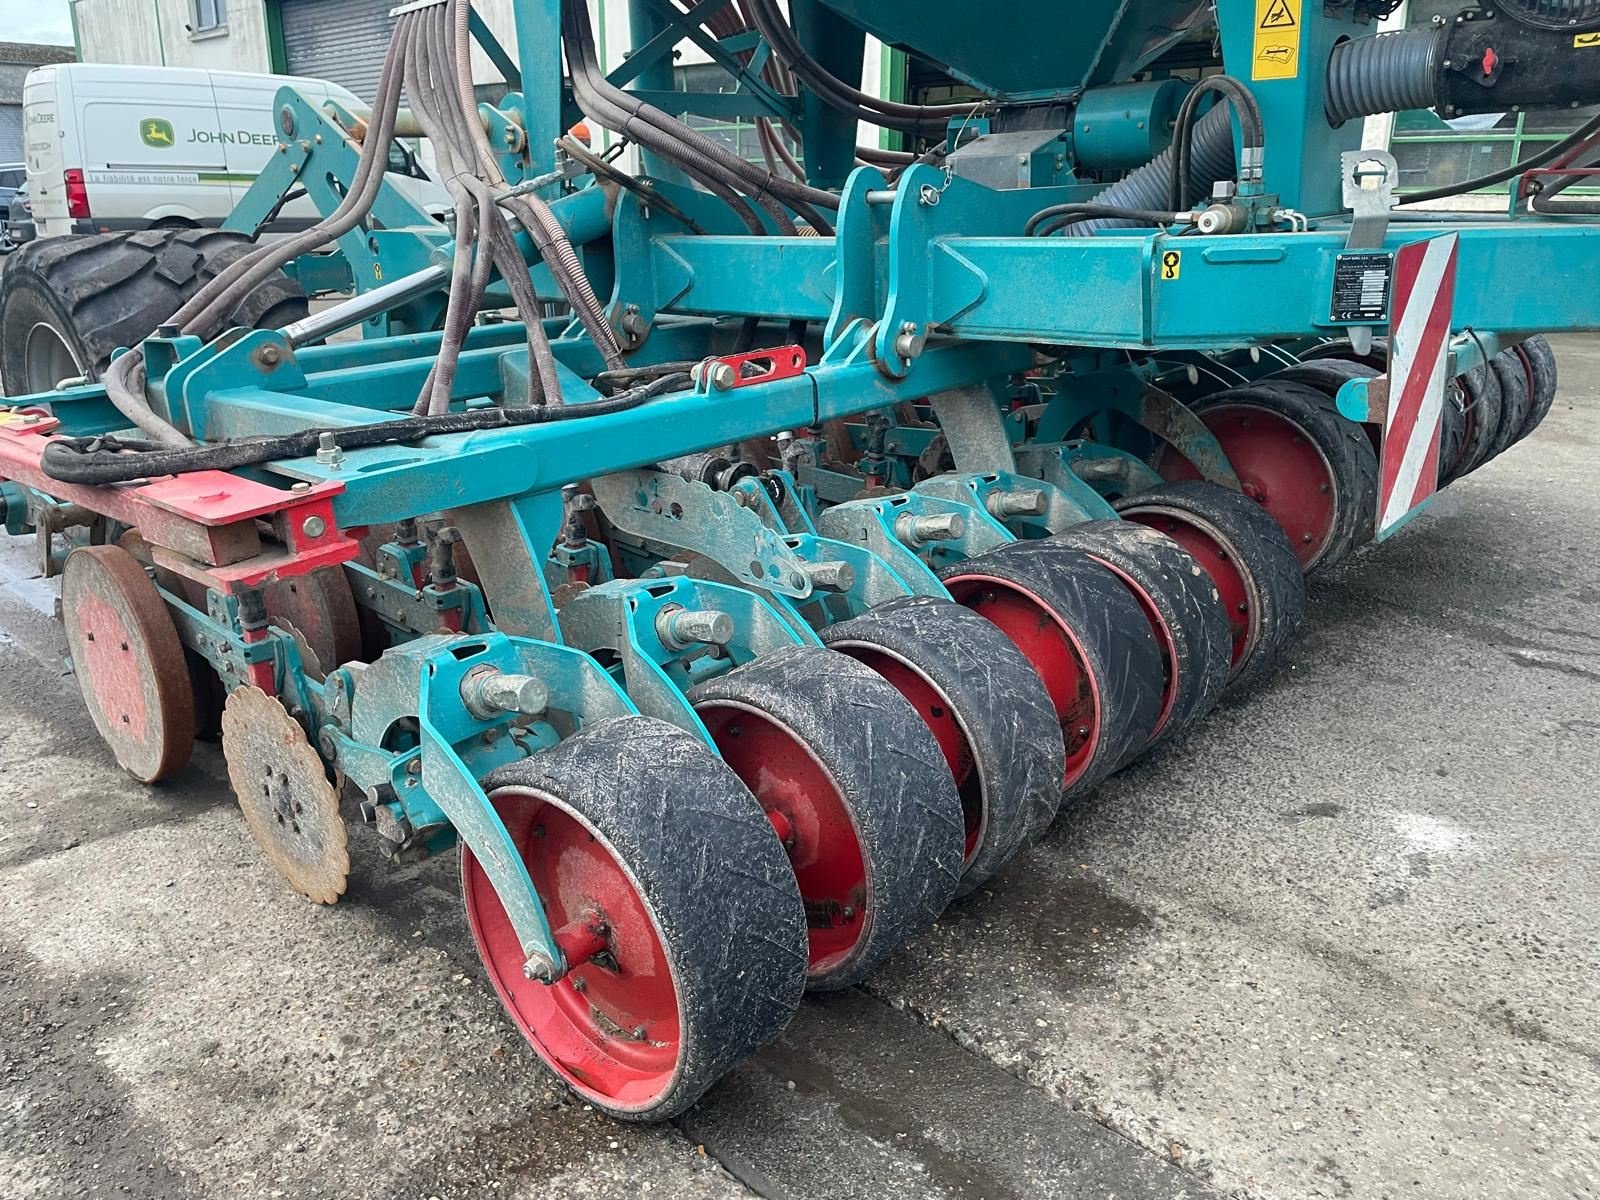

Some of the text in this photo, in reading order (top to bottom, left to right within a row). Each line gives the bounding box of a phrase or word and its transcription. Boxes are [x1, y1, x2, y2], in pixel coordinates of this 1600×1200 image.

[187, 128, 235, 144] JOHN
[89, 173, 100, 184] La
[137, 174, 151, 184] est
[153, 175, 175, 185] notre
[176, 175, 197, 185] force
